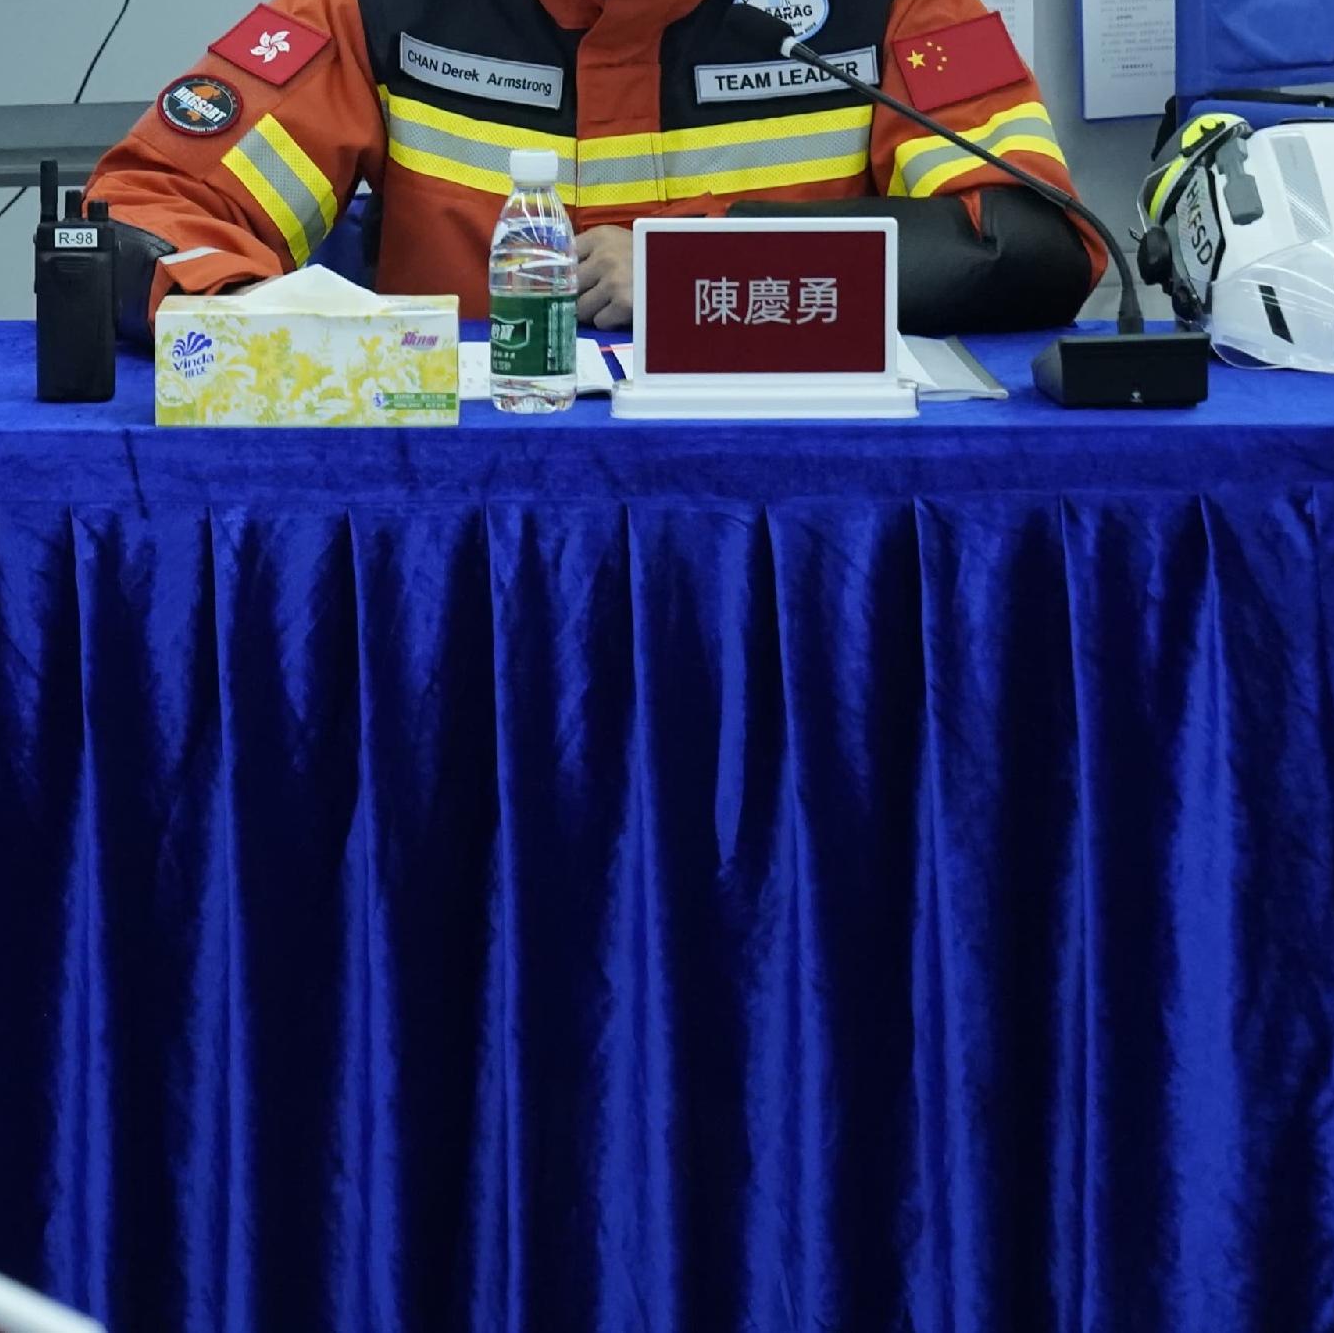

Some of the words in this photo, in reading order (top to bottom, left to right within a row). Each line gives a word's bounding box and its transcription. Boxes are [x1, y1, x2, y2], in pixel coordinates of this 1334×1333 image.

[407, 49, 438, 72] CHAN
[441, 62, 480, 82] Derek
[487, 72, 552, 96] Armstrong
[715, 74, 771, 91] TEAM
[58, 231, 93, 245] R-98
[694, 276, 838, 326] 陳慶勇
[173, 353, 214, 371] Vinda
